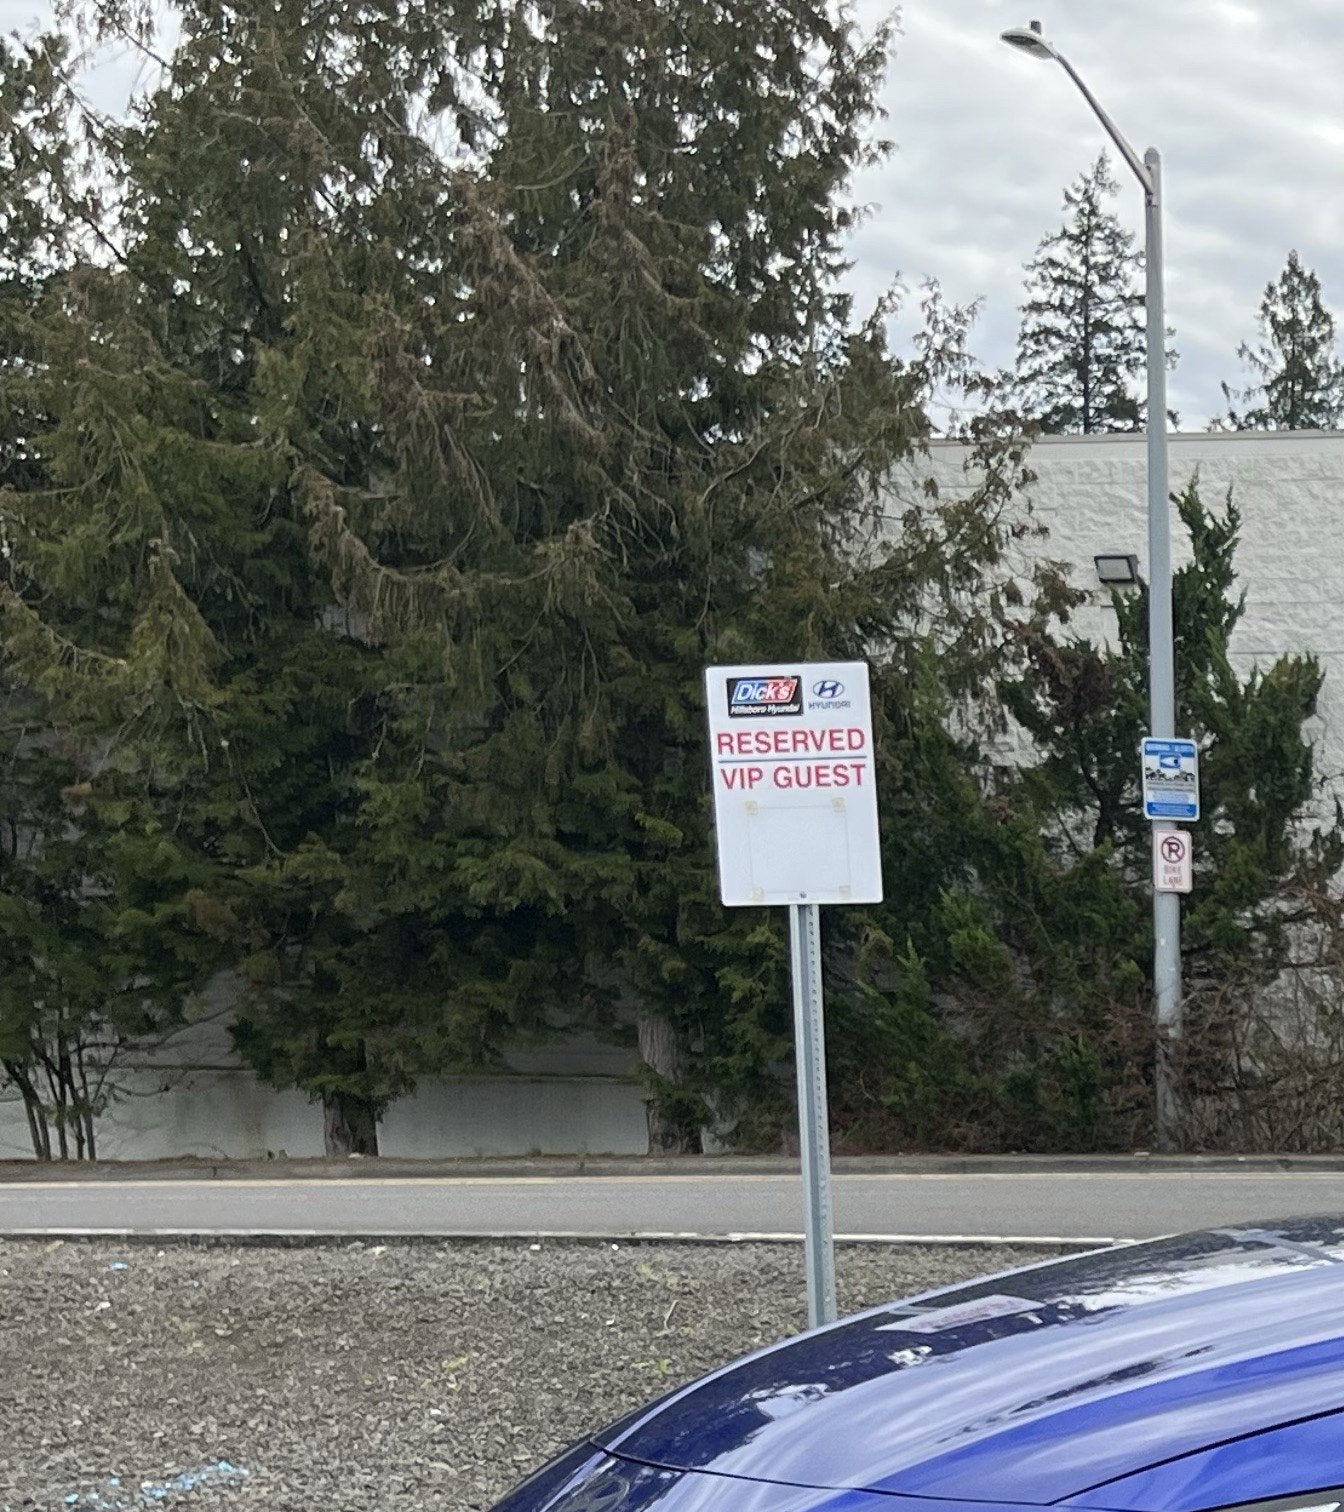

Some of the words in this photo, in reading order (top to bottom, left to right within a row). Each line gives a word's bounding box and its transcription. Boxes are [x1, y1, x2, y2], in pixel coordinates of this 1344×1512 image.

[716, 728, 866, 755] RESERVED
[720, 767, 763, 790] VIP
[773, 763, 866, 789] GUEST
